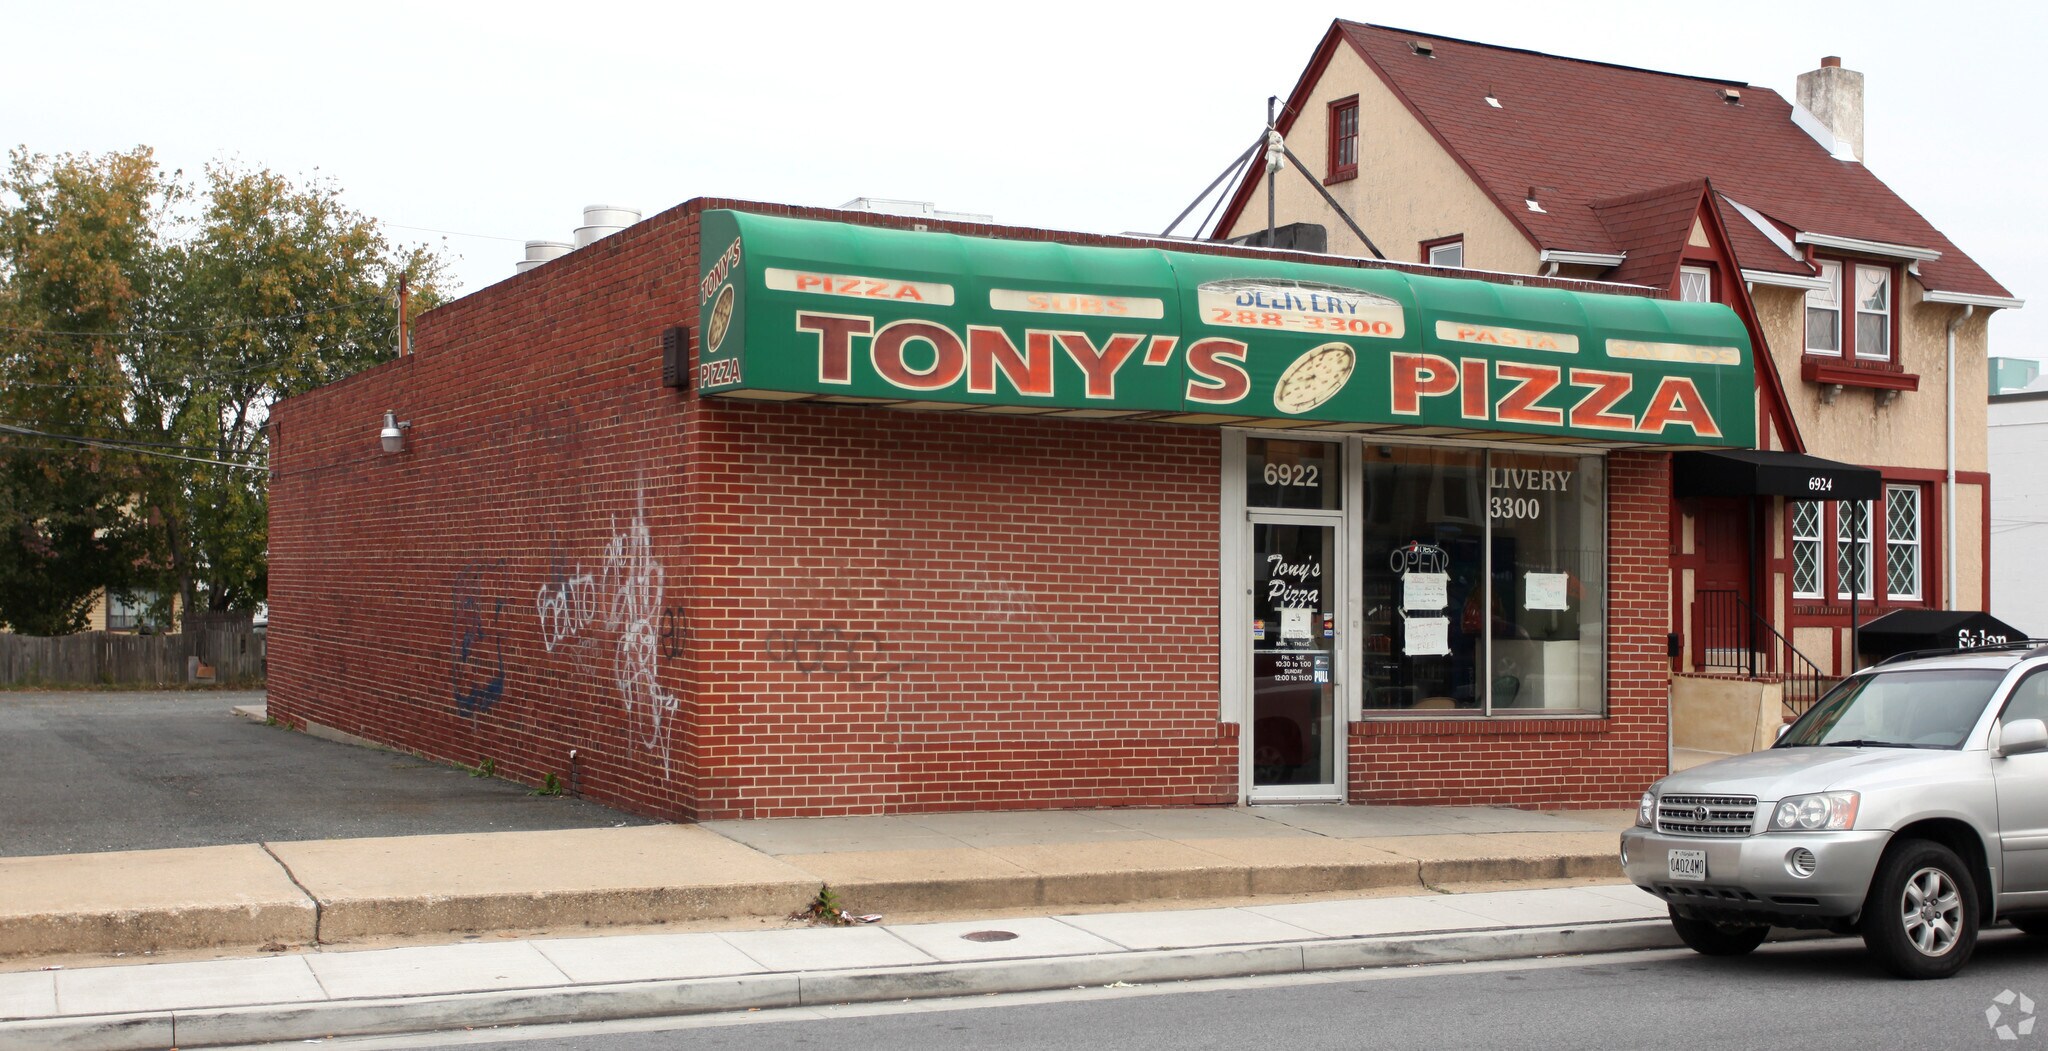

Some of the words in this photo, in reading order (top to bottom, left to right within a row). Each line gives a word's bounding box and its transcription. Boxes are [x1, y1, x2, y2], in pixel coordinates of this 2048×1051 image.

[701, 236, 741, 306] TONY'S
[796, 273, 923, 301] PIZZA
[1026, 293, 1129, 315] SUBS
[1212, 308, 1393, 335] 288-3300
[1458, 325, 1560, 349] PASTA
[1611, 342, 1736, 363] SALADS
[701, 357, 741, 389] PIZZA
[796, 310, 1251, 405] TONY'S
[1390, 351, 1724, 438] PIZZA
[1263, 463, 1318, 487] 6922
[1490, 467, 1571, 491] LIVERY
[1808, 477, 1832, 491] 6924
[1490, 496, 1540, 519] 3300
[1267, 553, 1321, 583] Tony's
[1390, 549, 1446, 574] OPEN
[1267, 579, 1319, 609] Pizza
[1314, 670, 1328, 682] PULL
